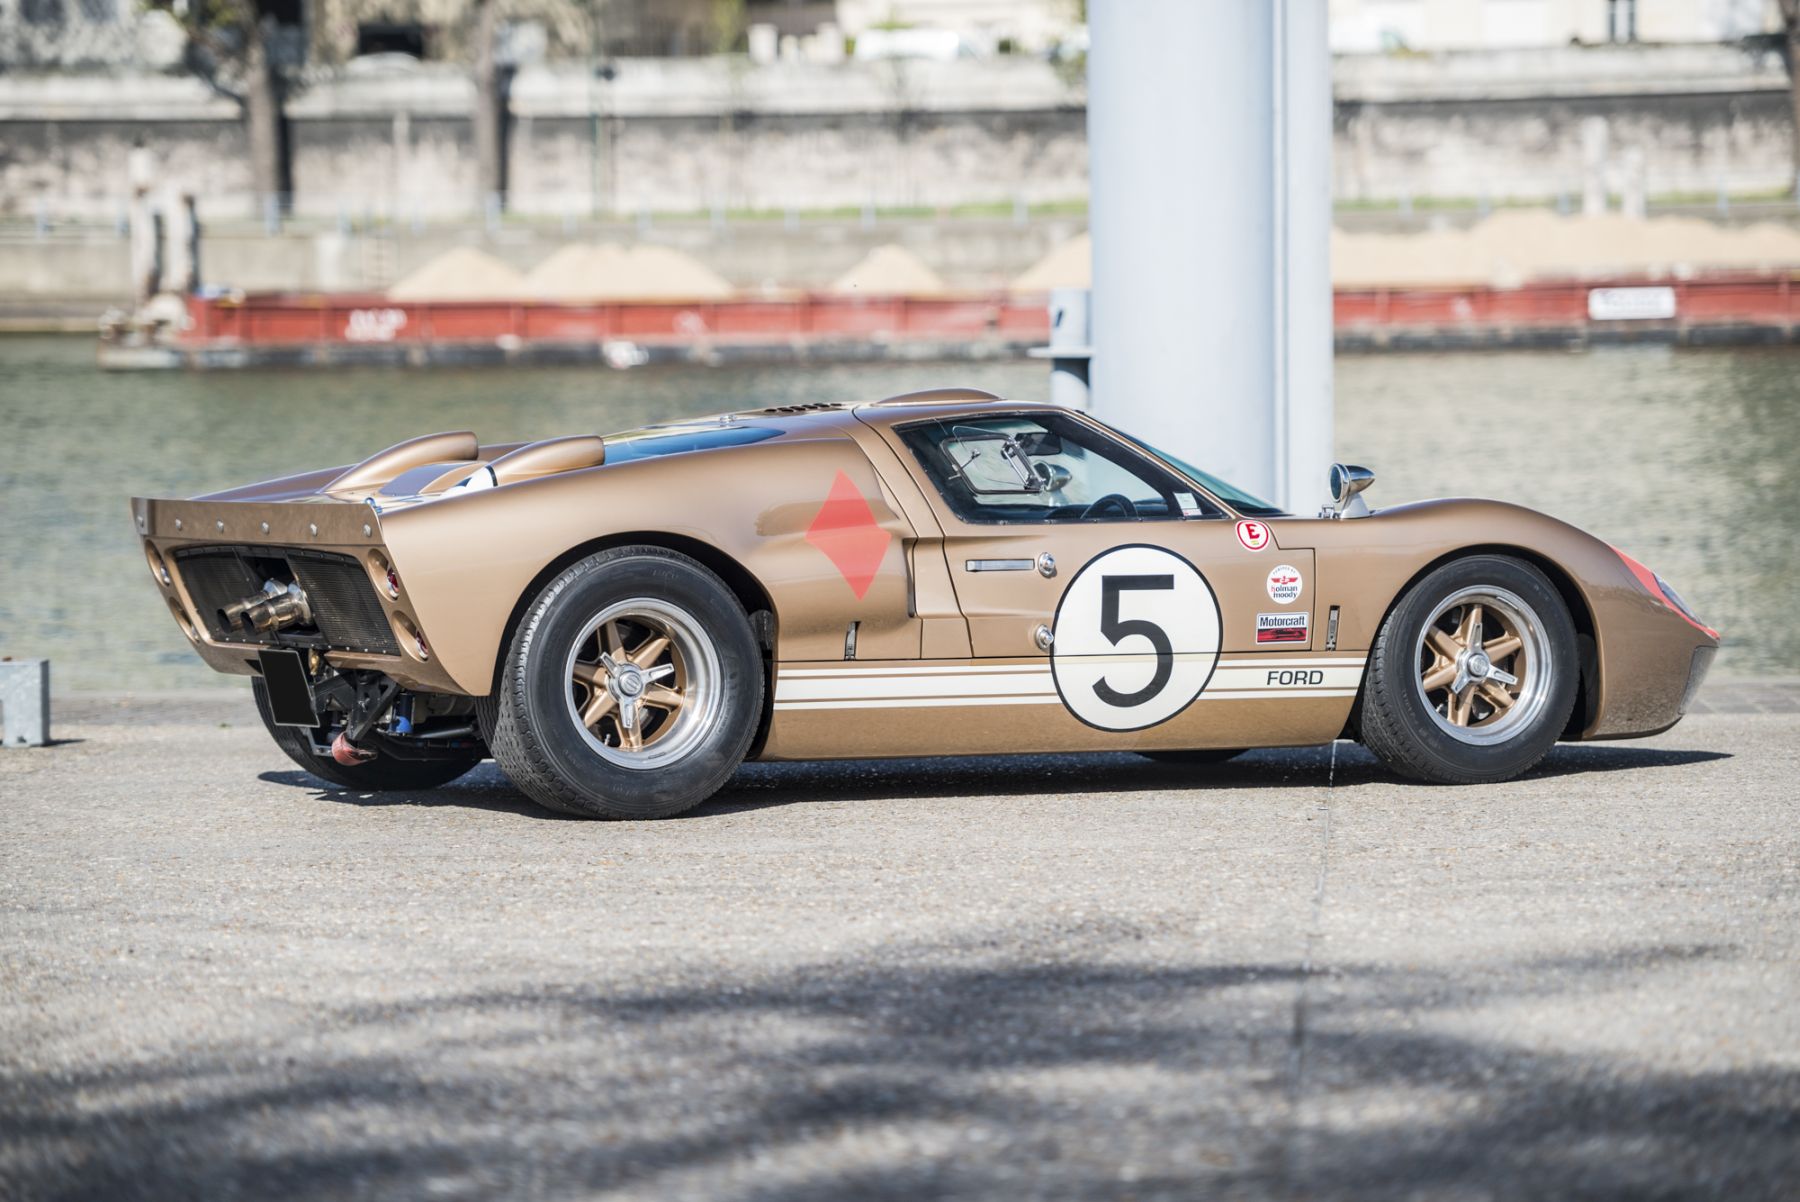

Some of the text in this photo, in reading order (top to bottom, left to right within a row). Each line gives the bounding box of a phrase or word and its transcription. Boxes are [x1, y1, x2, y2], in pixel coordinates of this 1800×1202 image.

[1245, 523, 1260, 539] E
[1260, 616, 1305, 627] Motorcraft
[1092, 574, 1174, 707] 5
[1266, 670, 1324, 686] FORD
